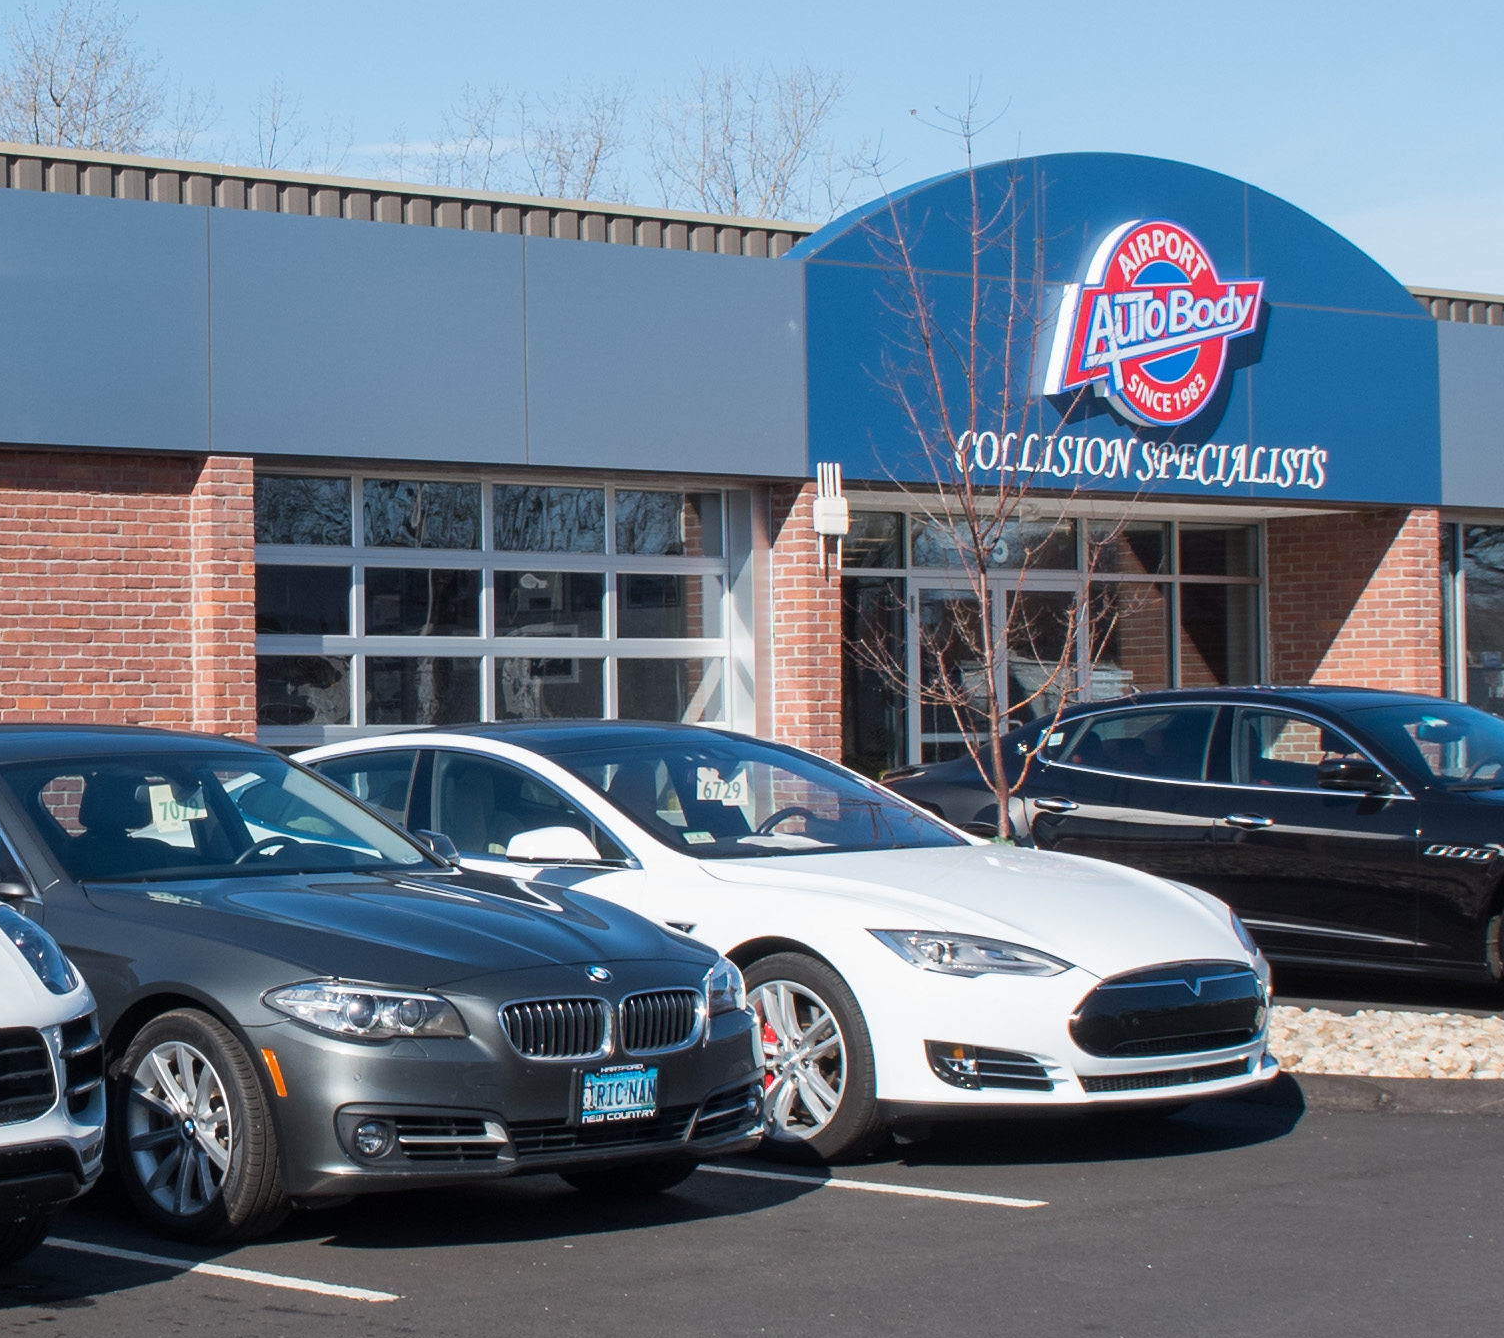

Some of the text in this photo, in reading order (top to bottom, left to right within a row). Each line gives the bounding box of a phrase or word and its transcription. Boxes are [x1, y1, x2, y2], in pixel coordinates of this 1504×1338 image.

[1118, 229, 1208, 283] AIRPORT
[1127, 372, 1207, 413] SINCE 1983
[954, 430, 1328, 490] COLLISION SPECIALISTS
[158, 797, 200, 821] 7079
[703, 781, 742, 799] 6729
